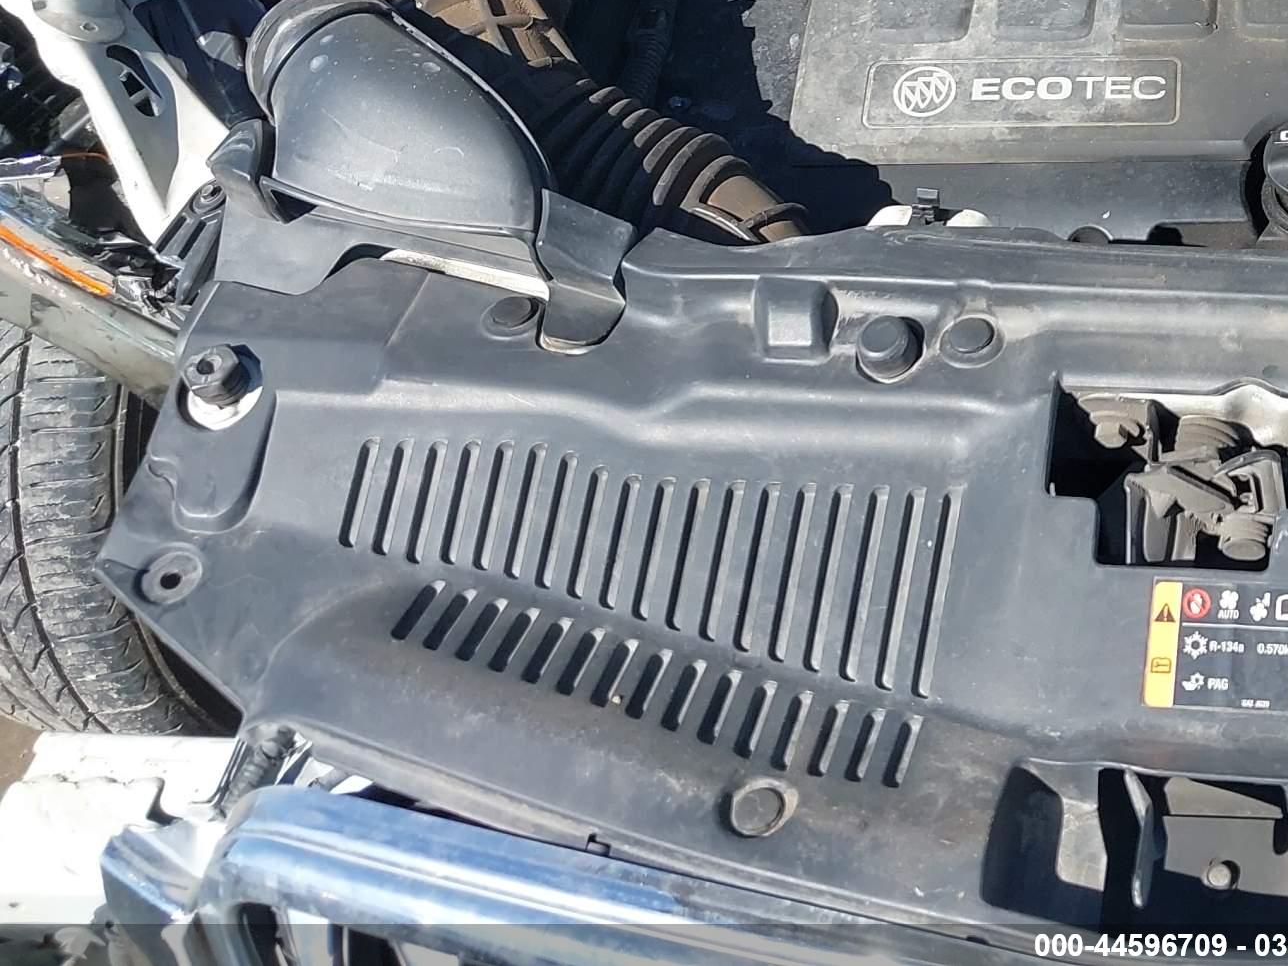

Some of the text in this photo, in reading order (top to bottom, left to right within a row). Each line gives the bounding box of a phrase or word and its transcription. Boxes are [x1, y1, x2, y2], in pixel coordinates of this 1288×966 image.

[971, 76, 1167, 101] ECOTEC
[1217, 609, 1240, 620] AUTO
[1208, 640, 1245, 653] R-134a
[1207, 677, 1229, 690] PAG
